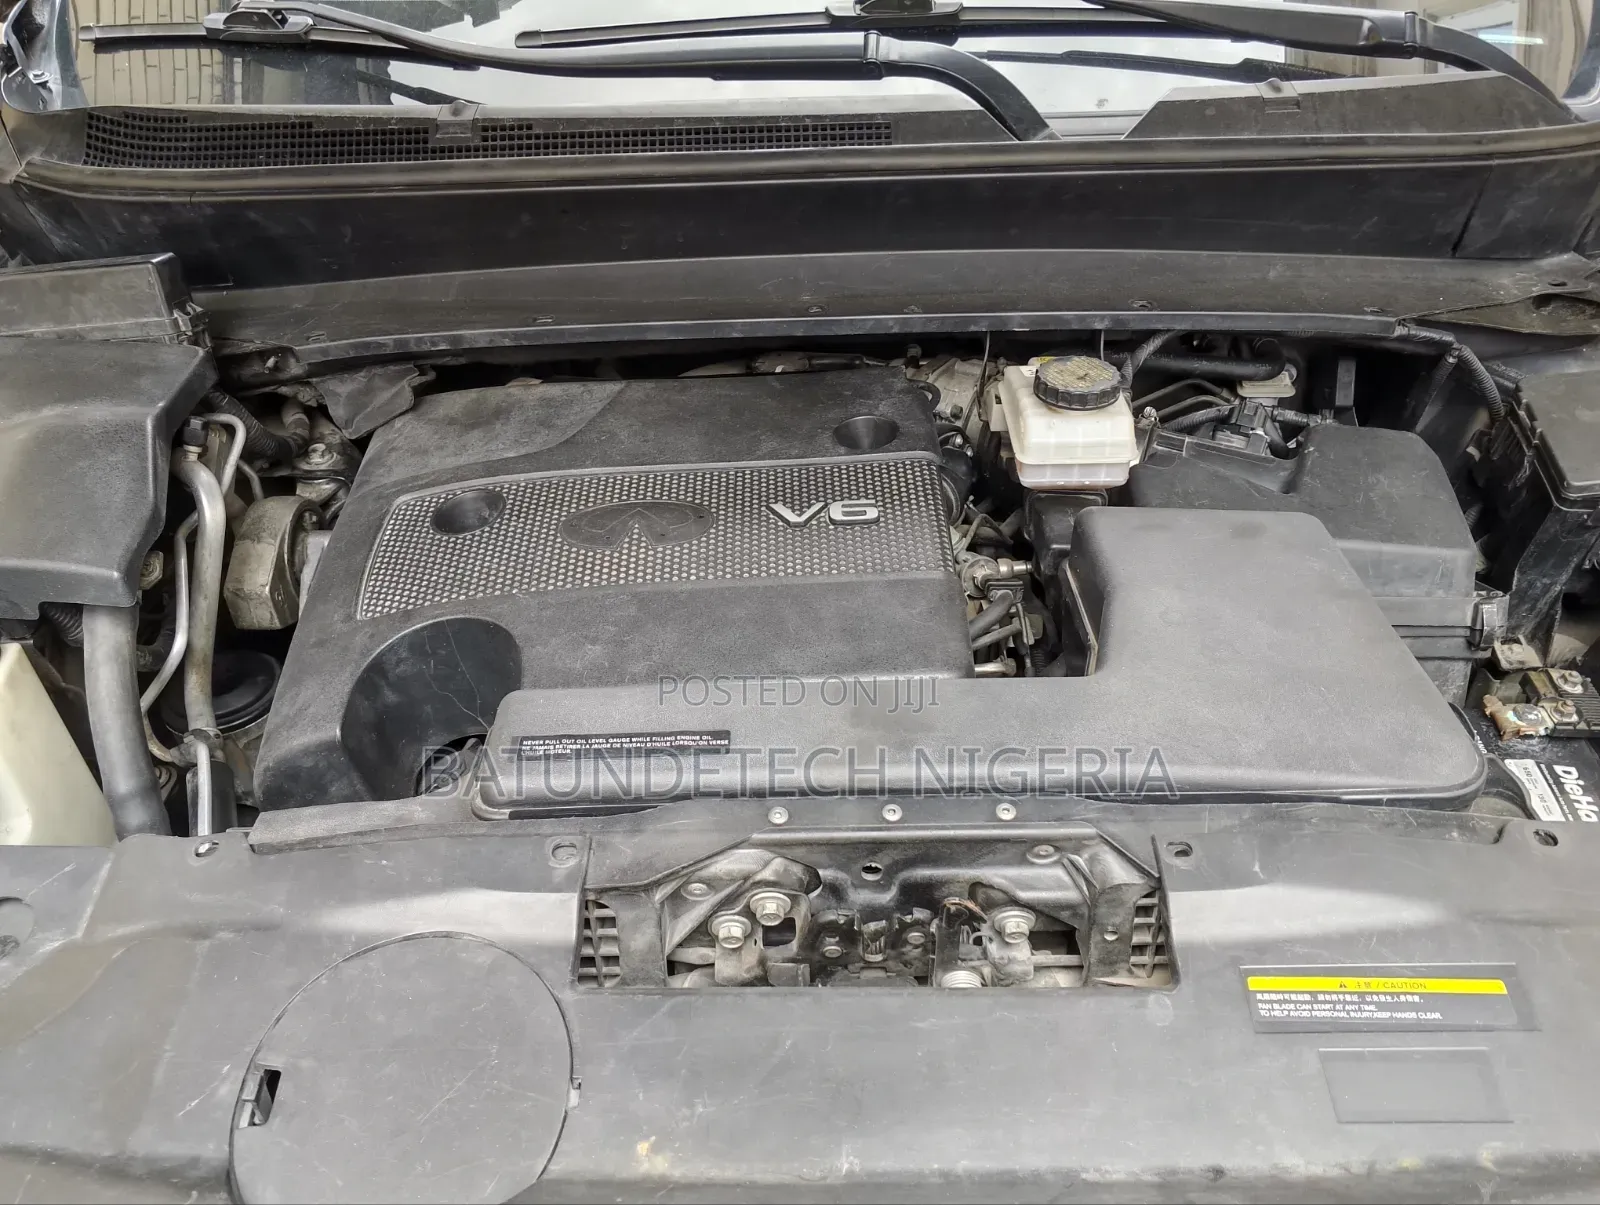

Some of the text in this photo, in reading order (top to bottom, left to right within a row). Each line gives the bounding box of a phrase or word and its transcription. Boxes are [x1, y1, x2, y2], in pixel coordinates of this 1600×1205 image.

[766, 500, 879, 527] V6
[1383, 981, 1427, 990] CAUTION
[1313, 1003, 1334, 1011] START
[1290, 1010, 1310, 1018] AVOID
